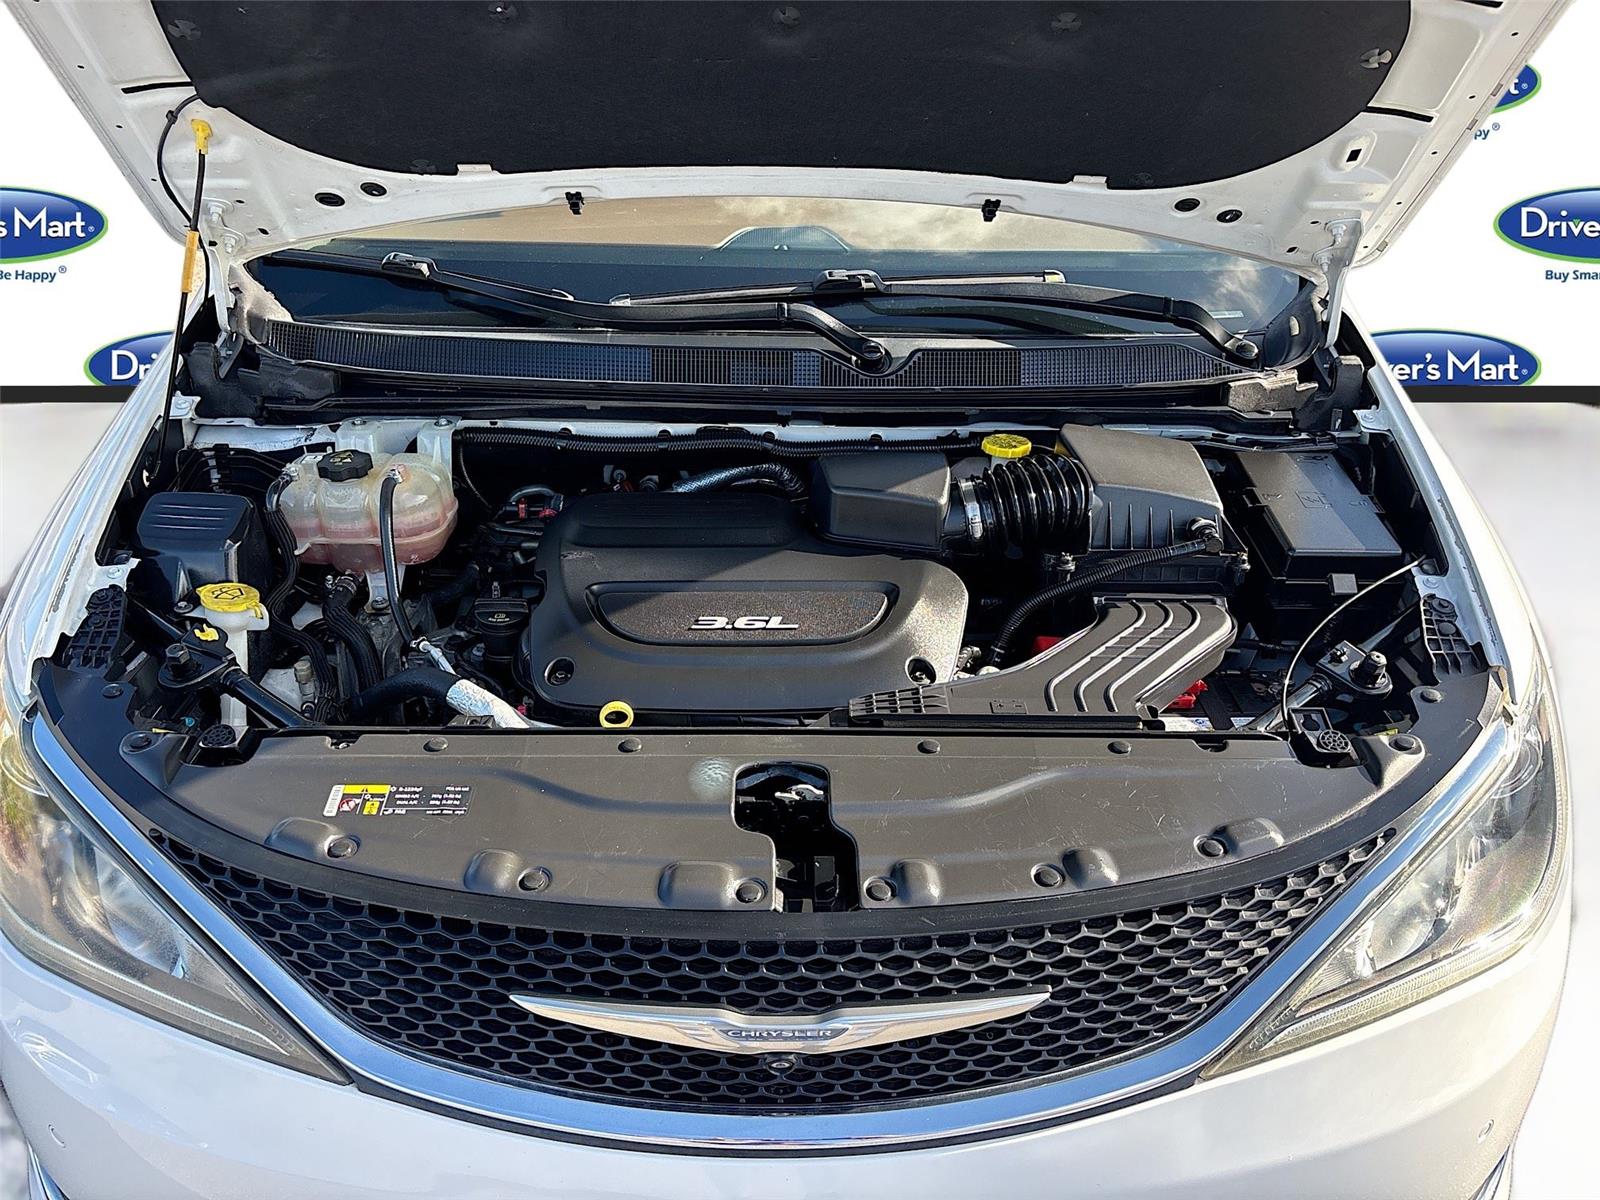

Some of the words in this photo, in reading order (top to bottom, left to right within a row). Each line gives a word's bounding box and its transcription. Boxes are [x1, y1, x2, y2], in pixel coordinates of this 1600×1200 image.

[14, 206, 86, 237] Mart
[15, 270, 57, 283] Happy
[1545, 270, 1569, 283] Buy
[1572, 270, 1600, 280] Sma
[1387, 352, 1441, 381] er's
[1447, 349, 1519, 380] Mart
[689, 616, 799, 629] 3.6L
